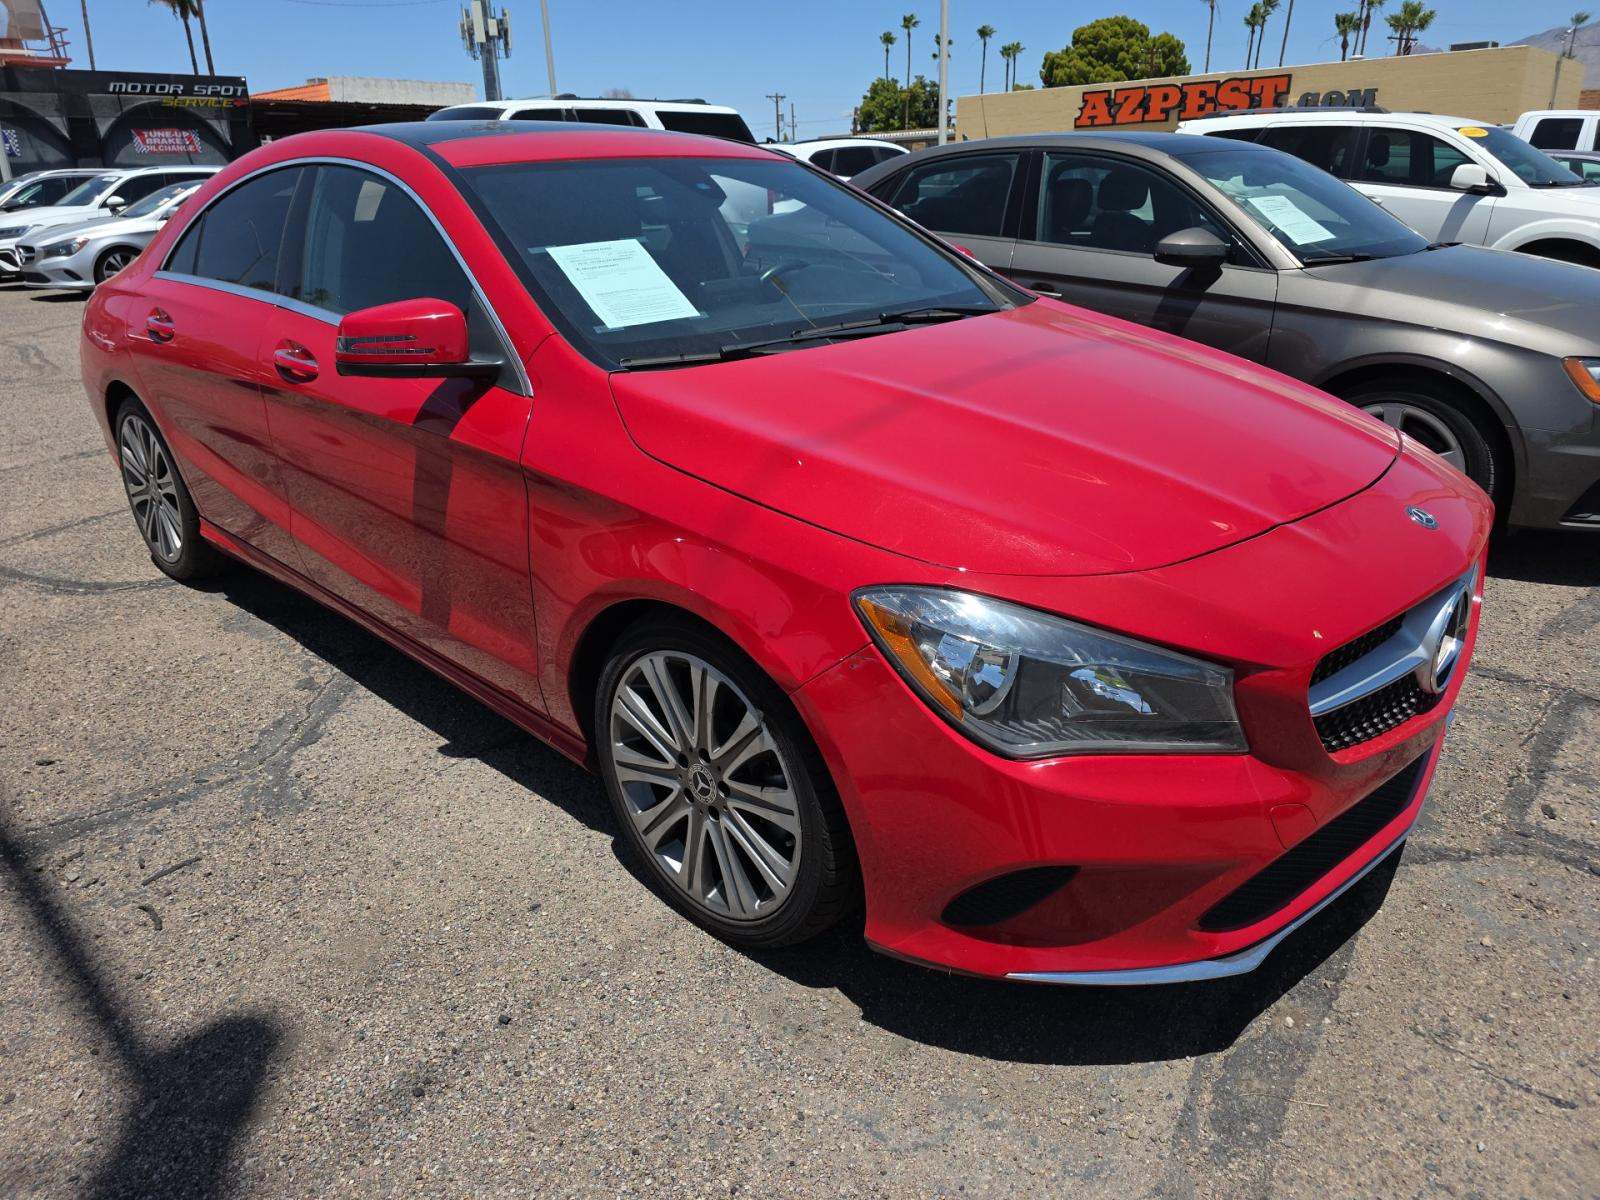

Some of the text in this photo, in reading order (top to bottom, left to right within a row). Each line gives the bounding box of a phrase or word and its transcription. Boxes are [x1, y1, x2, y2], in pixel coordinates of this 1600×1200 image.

[109, 82, 247, 96] MOTOR SPOT
[162, 97, 233, 108] SERVICE
